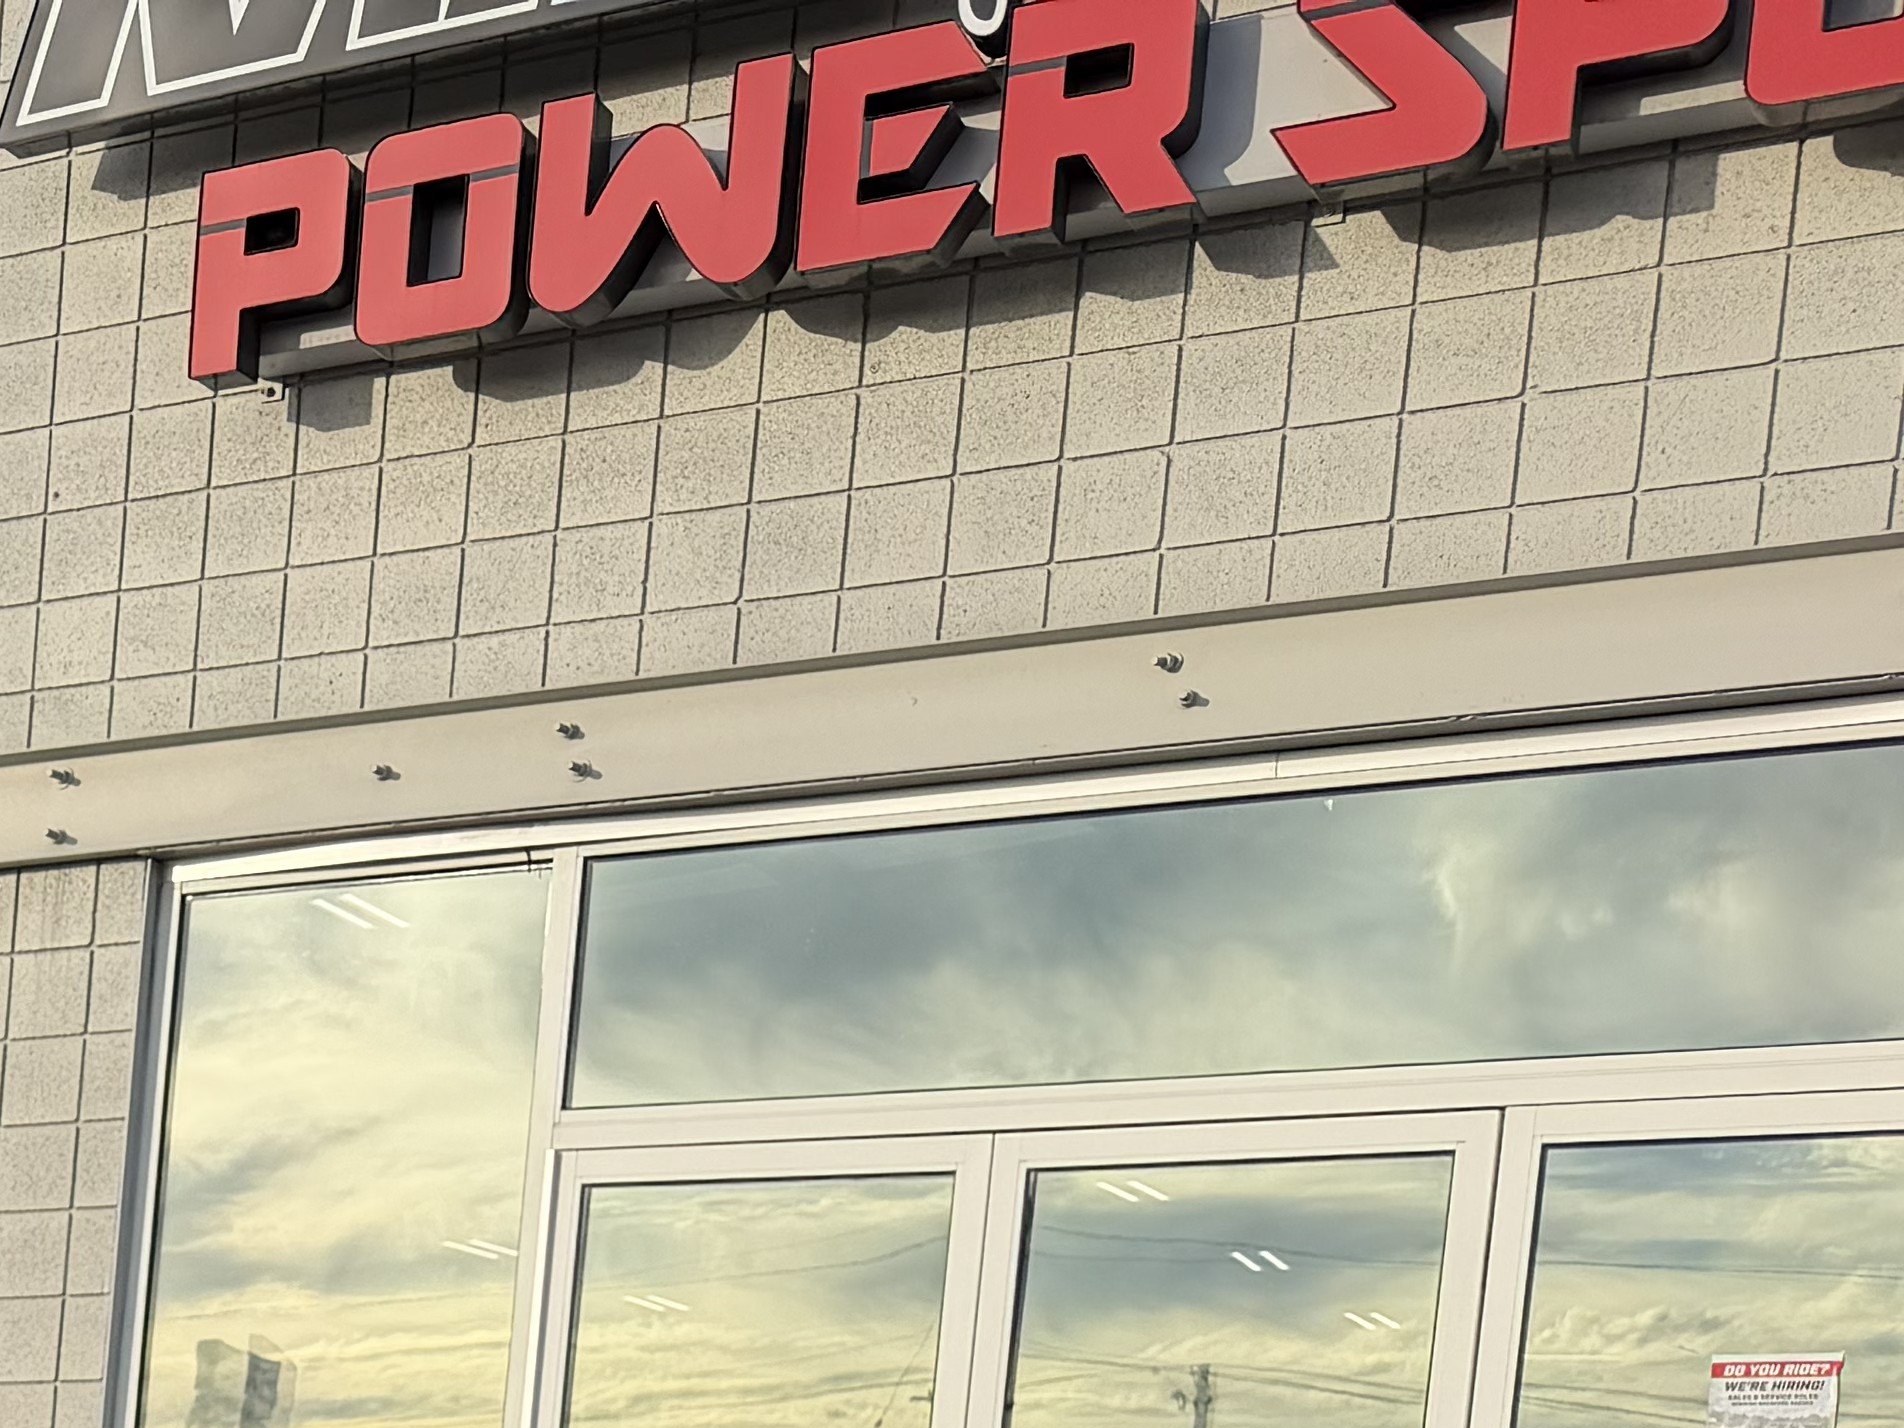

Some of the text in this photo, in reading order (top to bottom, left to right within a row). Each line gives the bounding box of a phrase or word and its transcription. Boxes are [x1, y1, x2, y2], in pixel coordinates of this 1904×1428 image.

[188, 0, 1202, 379] POWER
[1723, 1363, 1830, 1377] DO YOU RIDE?
[1725, 1380, 1825, 1392] WE'RE HIRING!
